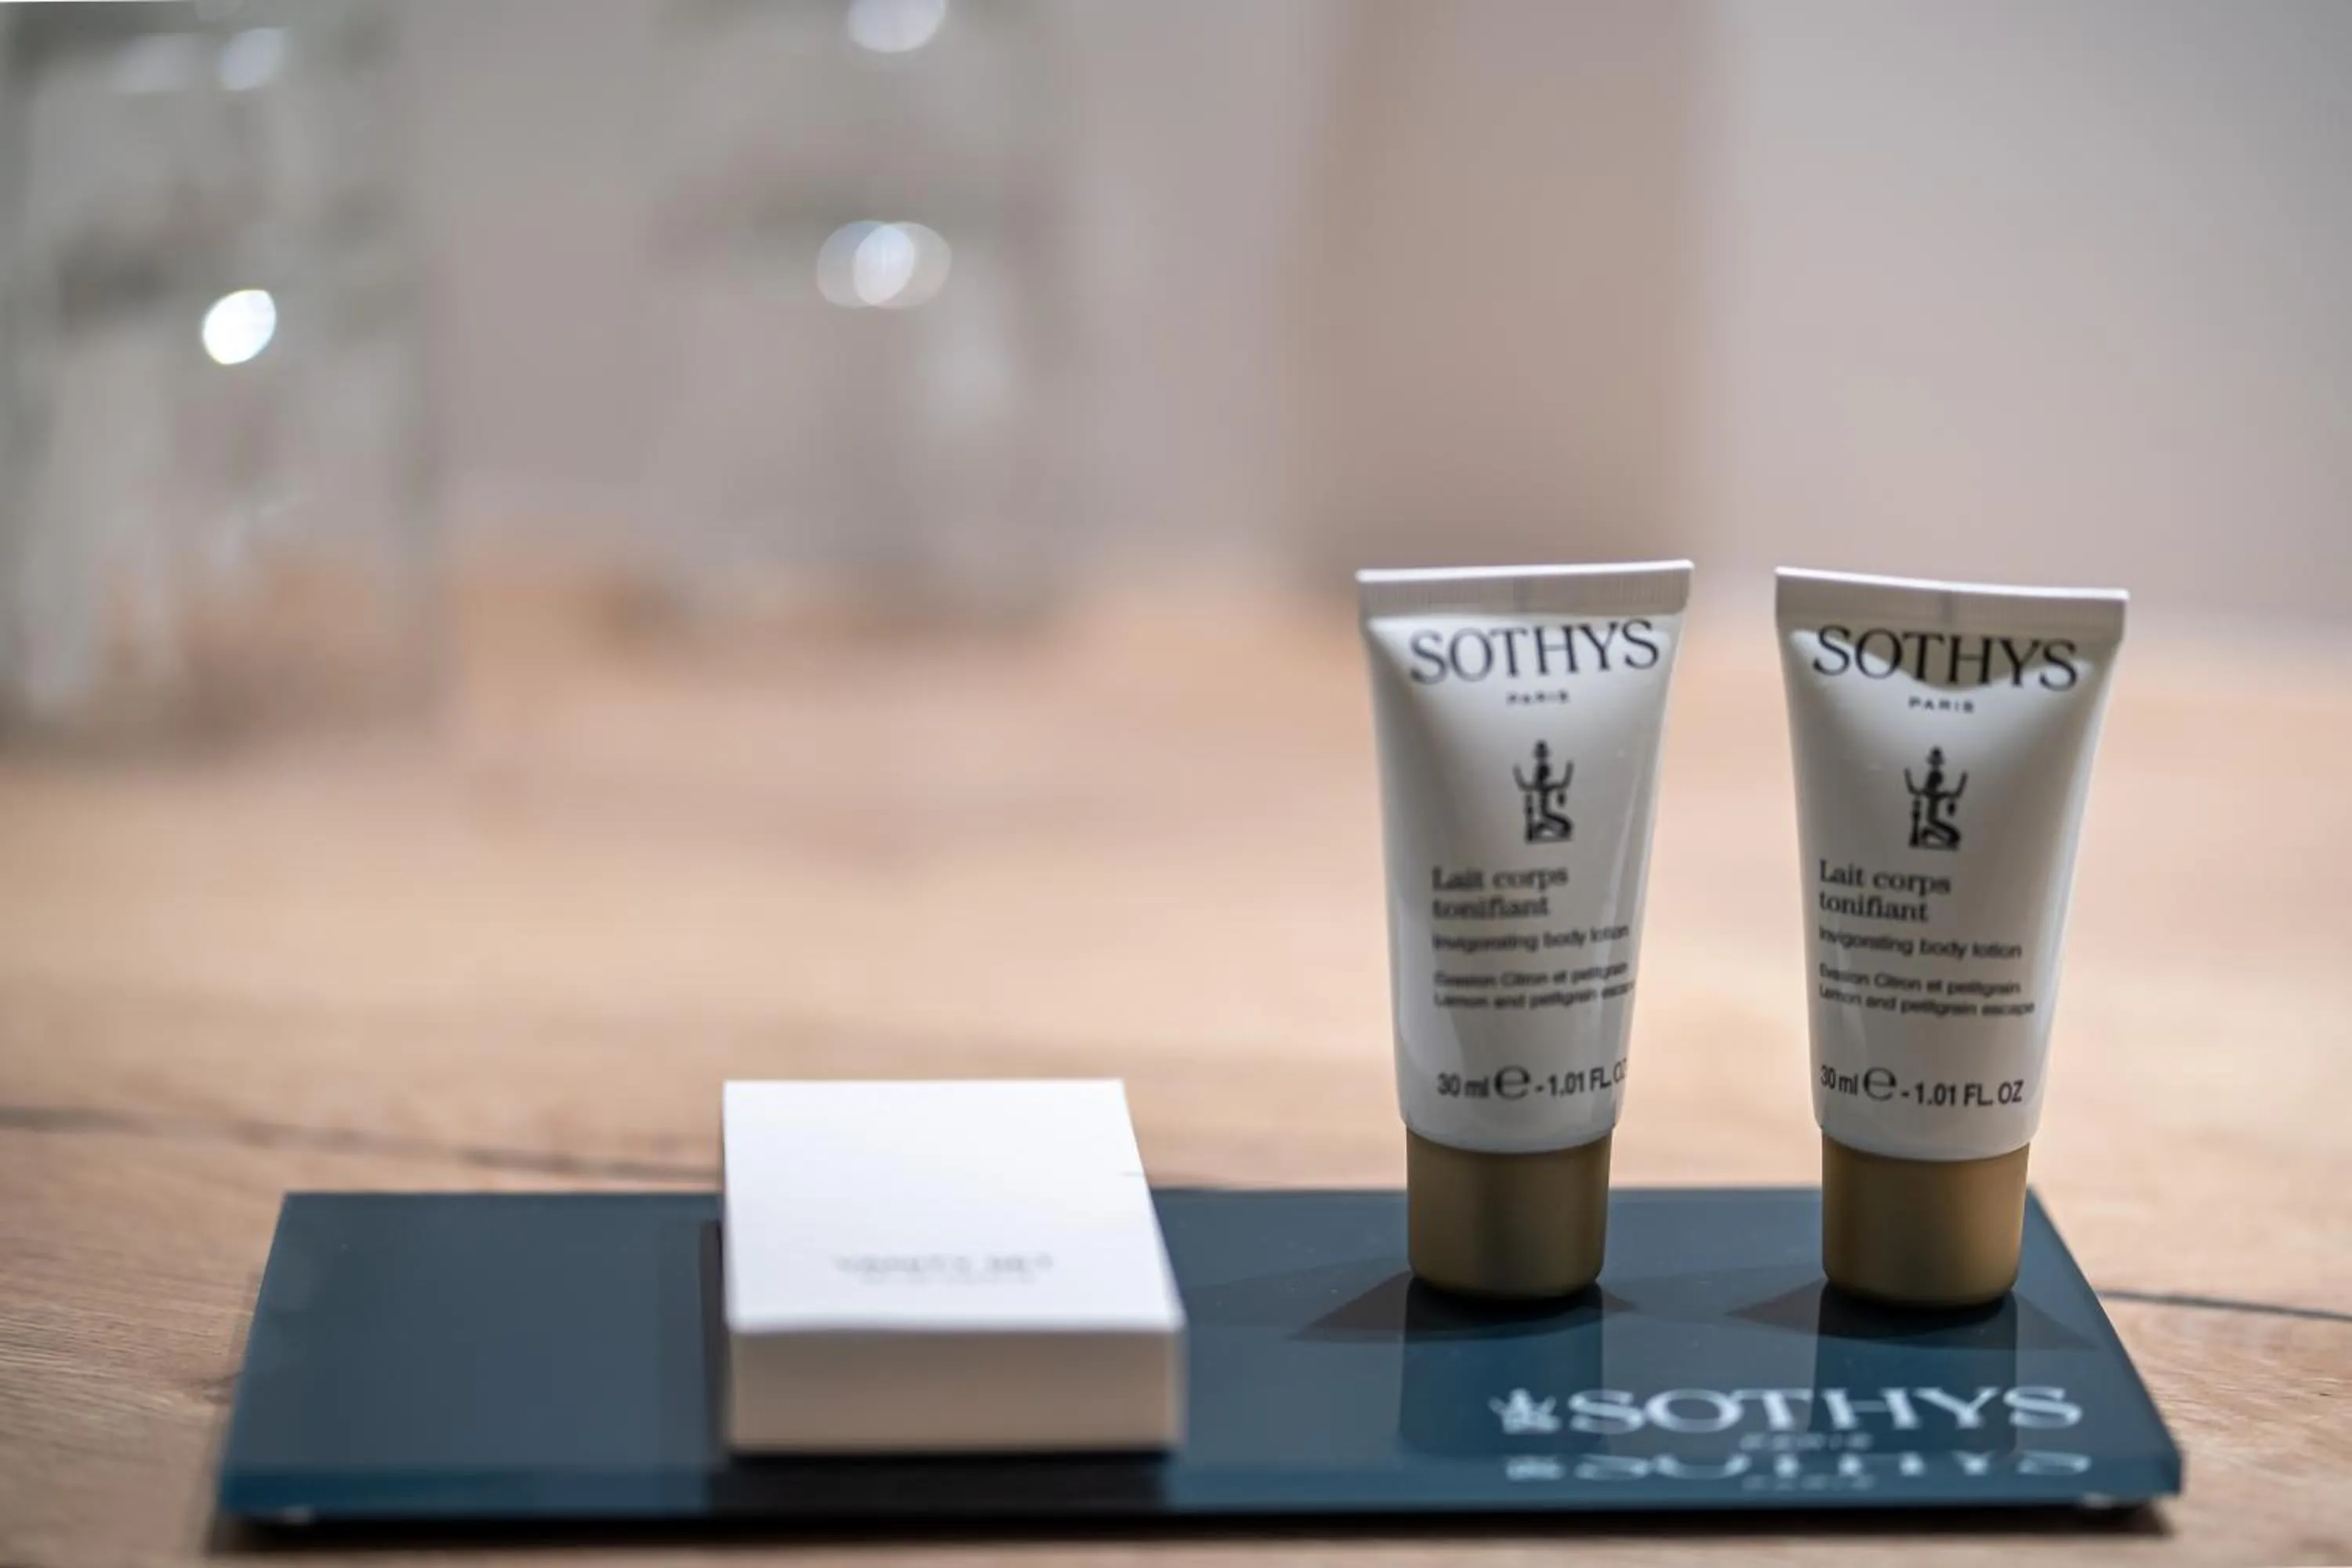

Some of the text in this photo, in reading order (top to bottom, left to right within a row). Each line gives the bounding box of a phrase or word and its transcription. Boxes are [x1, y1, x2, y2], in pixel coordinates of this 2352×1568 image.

[1410, 618, 1661, 684] SOTHYS
[1813, 624, 2078, 691] SOTHYS
[1908, 696, 1975, 713] PARIS
[1432, 866, 1569, 892] Lait corps
[1819, 859, 1952, 897] Lait corps
[1819, 891, 1929, 923] tonifiant
[1819, 925, 2023, 960] Invigorating body lotion
[1865, 995, 1896, 1011] and
[1437, 1071, 1461, 1098] 30
[1548, 1071, 1584, 1098] 1.01
[1820, 1064, 1836, 1090] 30
[1838, 1073, 1859, 1096] ml
[1915, 1080, 1957, 1107] 1.01
[1998, 1079, 2024, 1105] OZ
[1568, 1386, 2083, 1433] SOTHYS
